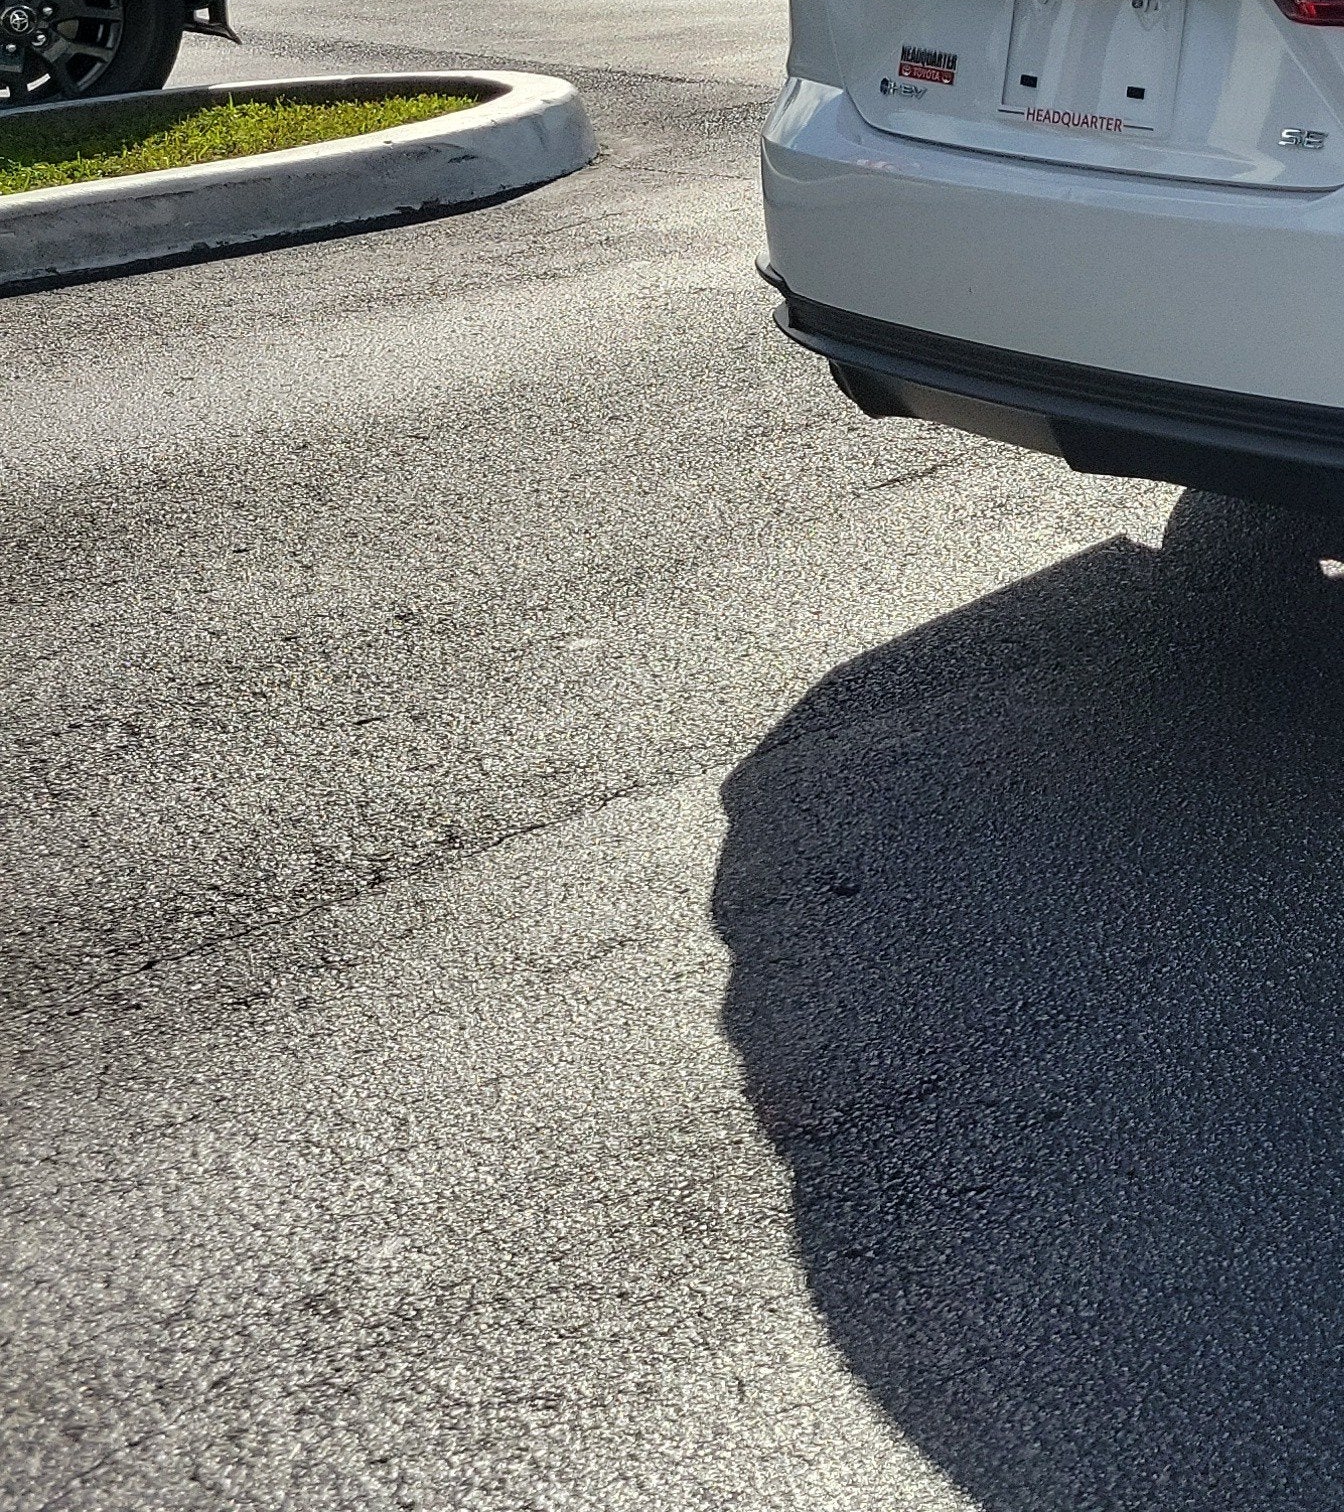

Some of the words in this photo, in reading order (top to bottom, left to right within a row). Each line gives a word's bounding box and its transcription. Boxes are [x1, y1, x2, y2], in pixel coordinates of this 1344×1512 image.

[901, 45, 958, 71] HEADQUARTER
[913, 67, 940, 81] TOYOTA
[1026, 107, 1123, 132] HEADQUARTER
[1278, 128, 1329, 149] SE
